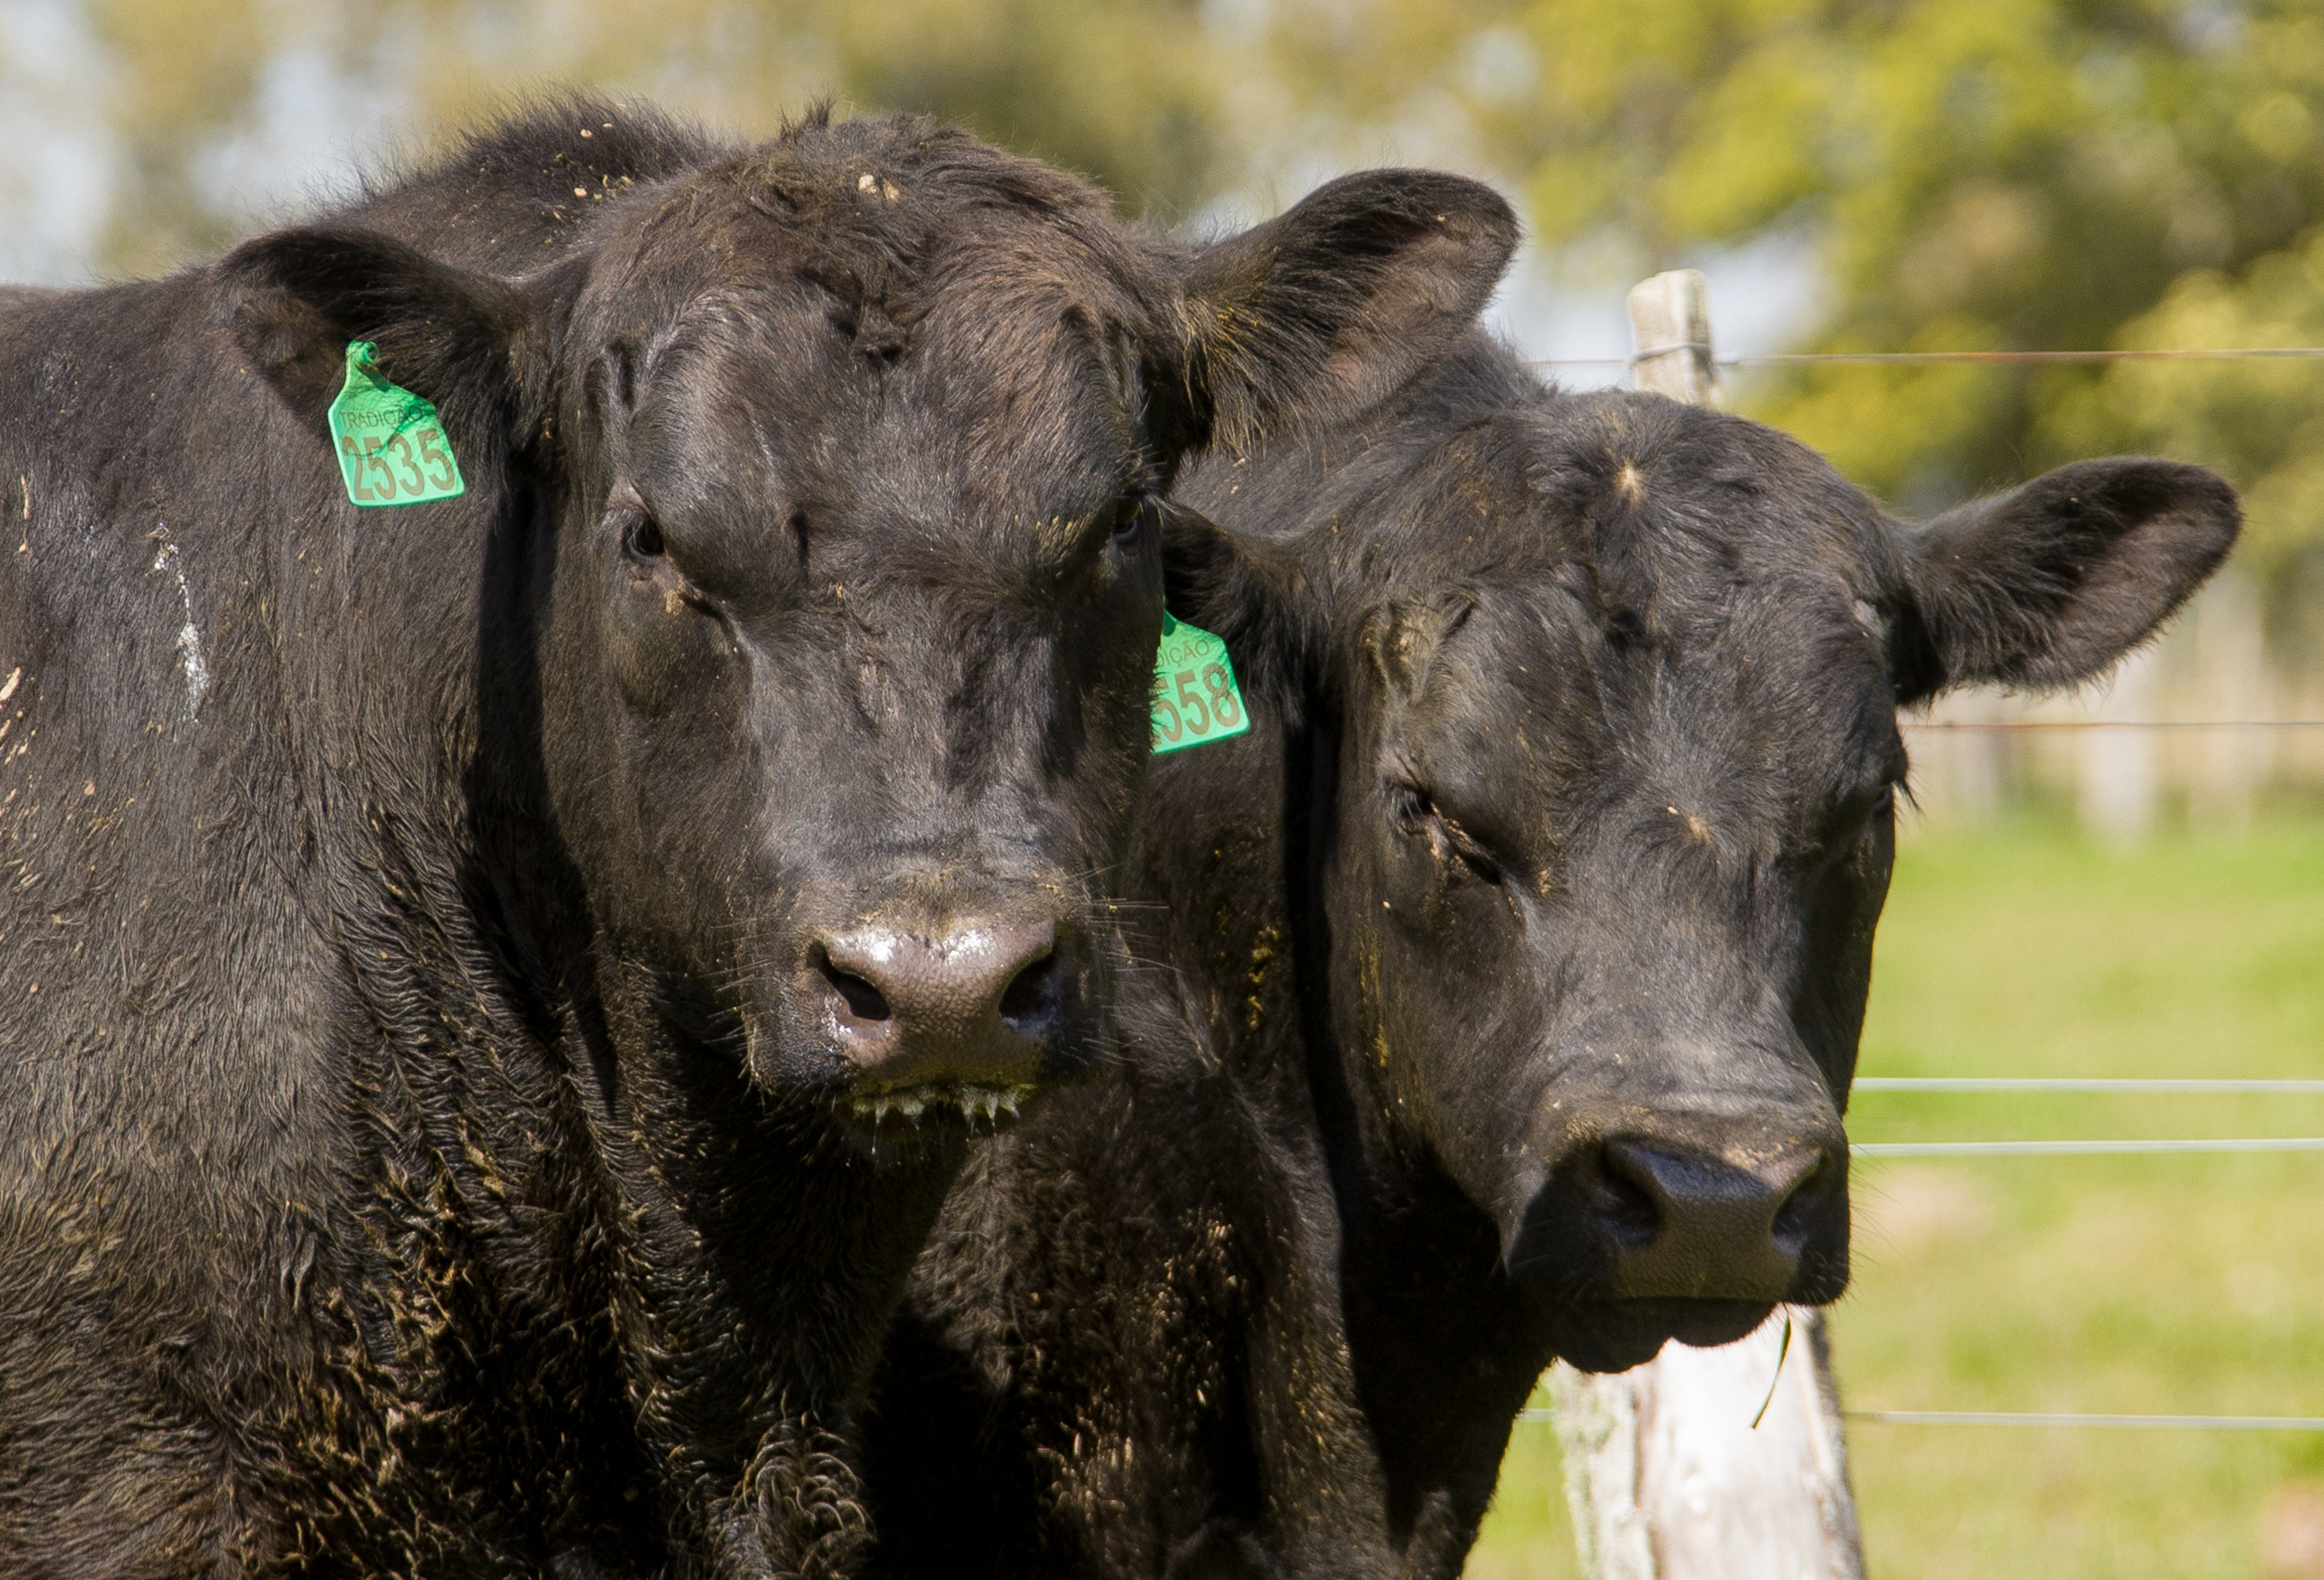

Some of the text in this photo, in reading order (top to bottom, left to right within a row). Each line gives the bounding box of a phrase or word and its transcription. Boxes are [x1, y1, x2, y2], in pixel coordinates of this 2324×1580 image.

[339, 405, 423, 429] TRADIÇÃO
[341, 428, 455, 500] 2535
[1151, 662, 1240, 747] 558
